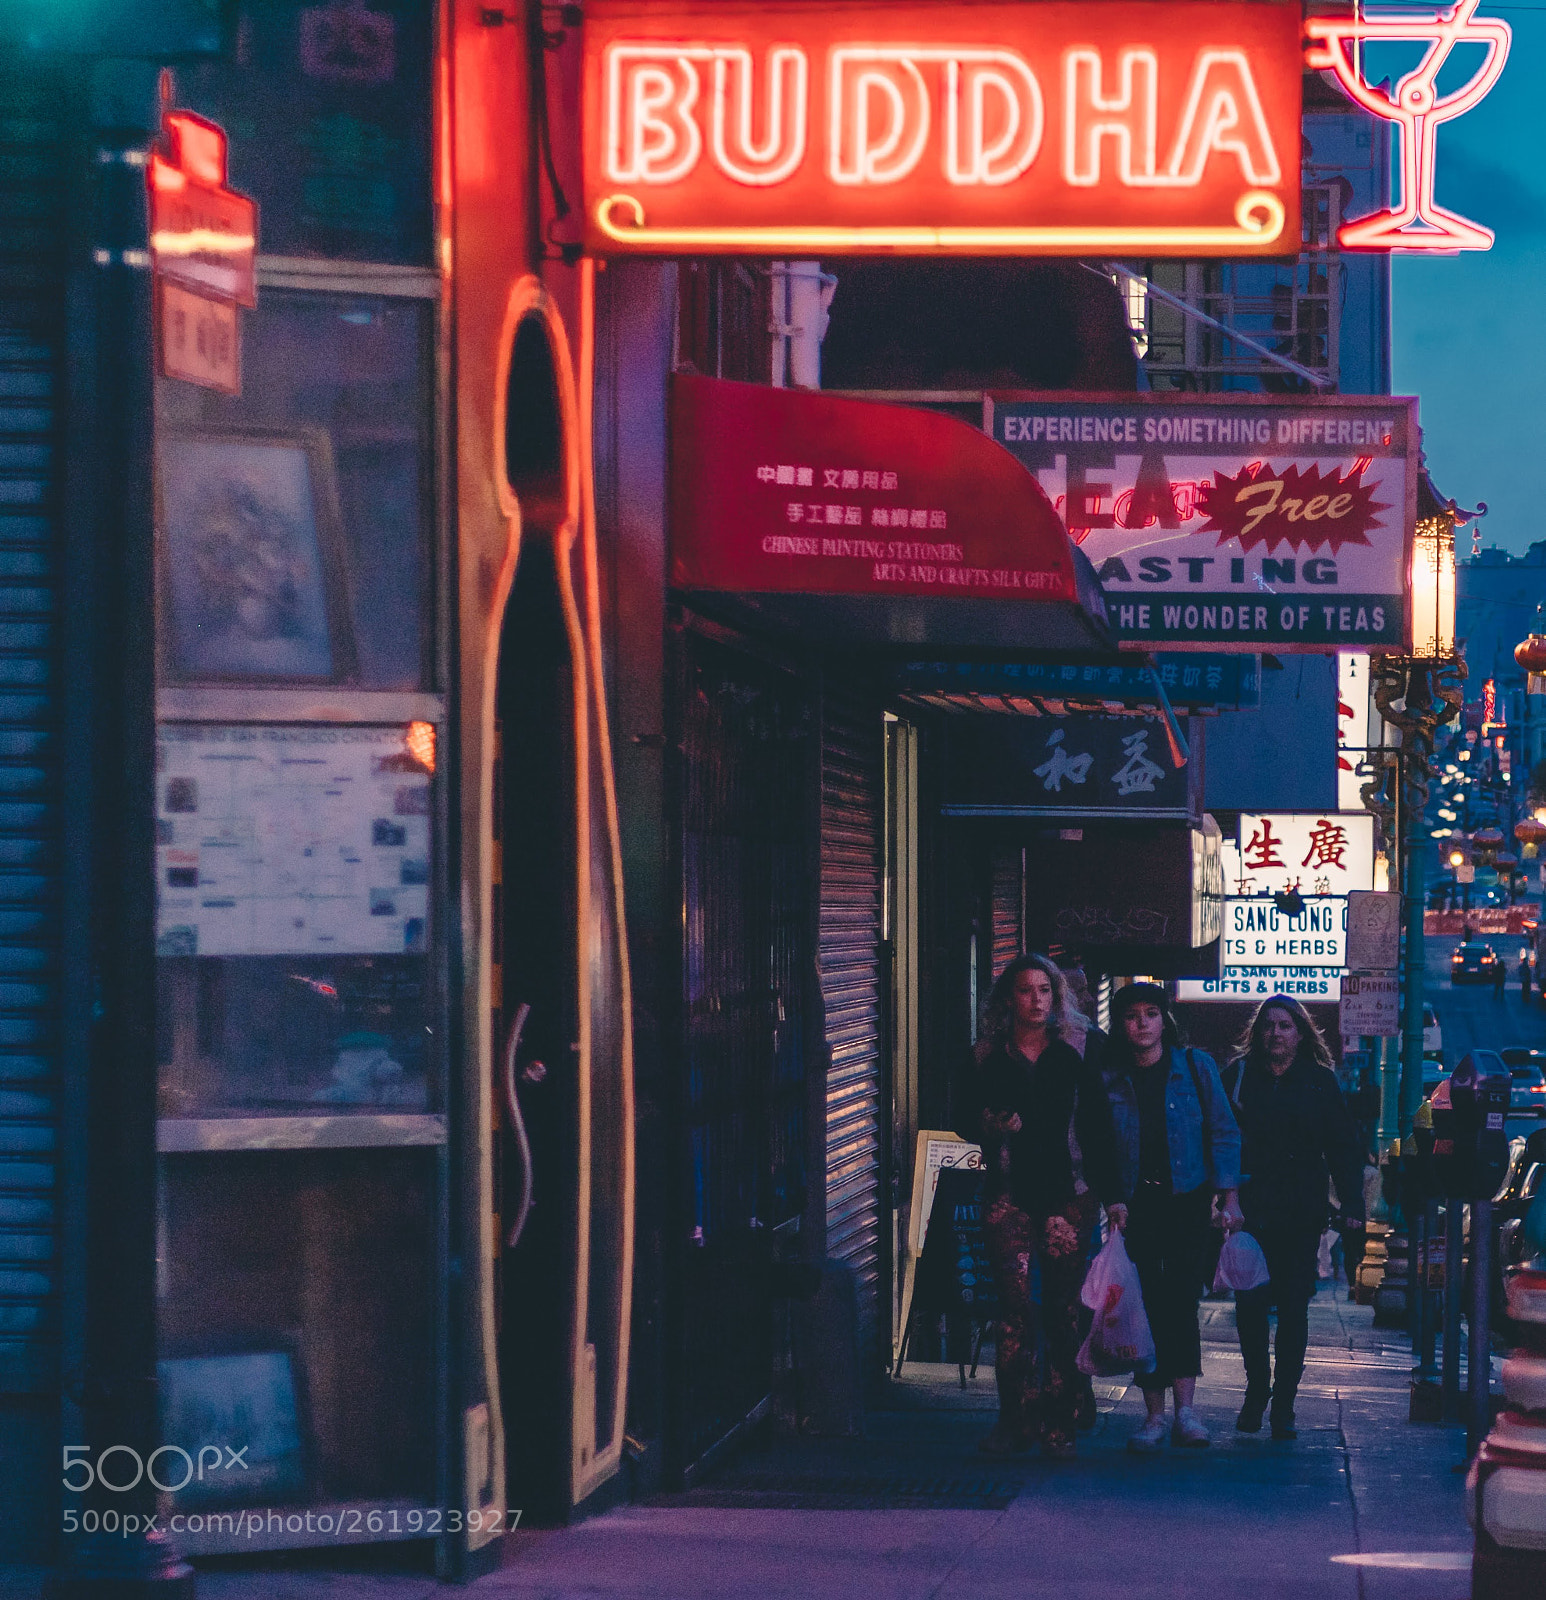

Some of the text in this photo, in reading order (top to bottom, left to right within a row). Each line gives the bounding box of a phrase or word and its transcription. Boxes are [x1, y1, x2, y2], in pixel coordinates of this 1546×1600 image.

[605, 44, 1284, 188] BUDDHA
[1004, 416, 1394, 446] EXPERIENCE SOMETHING DIFFERENT
[1032, 455, 1181, 530] EA
[1235, 479, 1353, 535] Free
[762, 536, 818, 555] CHINESE
[822, 538, 884, 559] PAINTING
[872, 562, 1063, 591] ARTS AND CRAFTS SILK GIFTS
[1163, 605, 1268, 631] WONDER
[1280, 606, 1310, 631] OF
[1323, 606, 1385, 632] TEAS
[1234, 906, 1280, 932] SANG
[1255, 939, 1266, 955] &
[1276, 939, 1338, 955] HERBS
[1202, 980, 1329, 994] GIFTS & HERBS
[1360, 981, 1398, 993] PARKING
